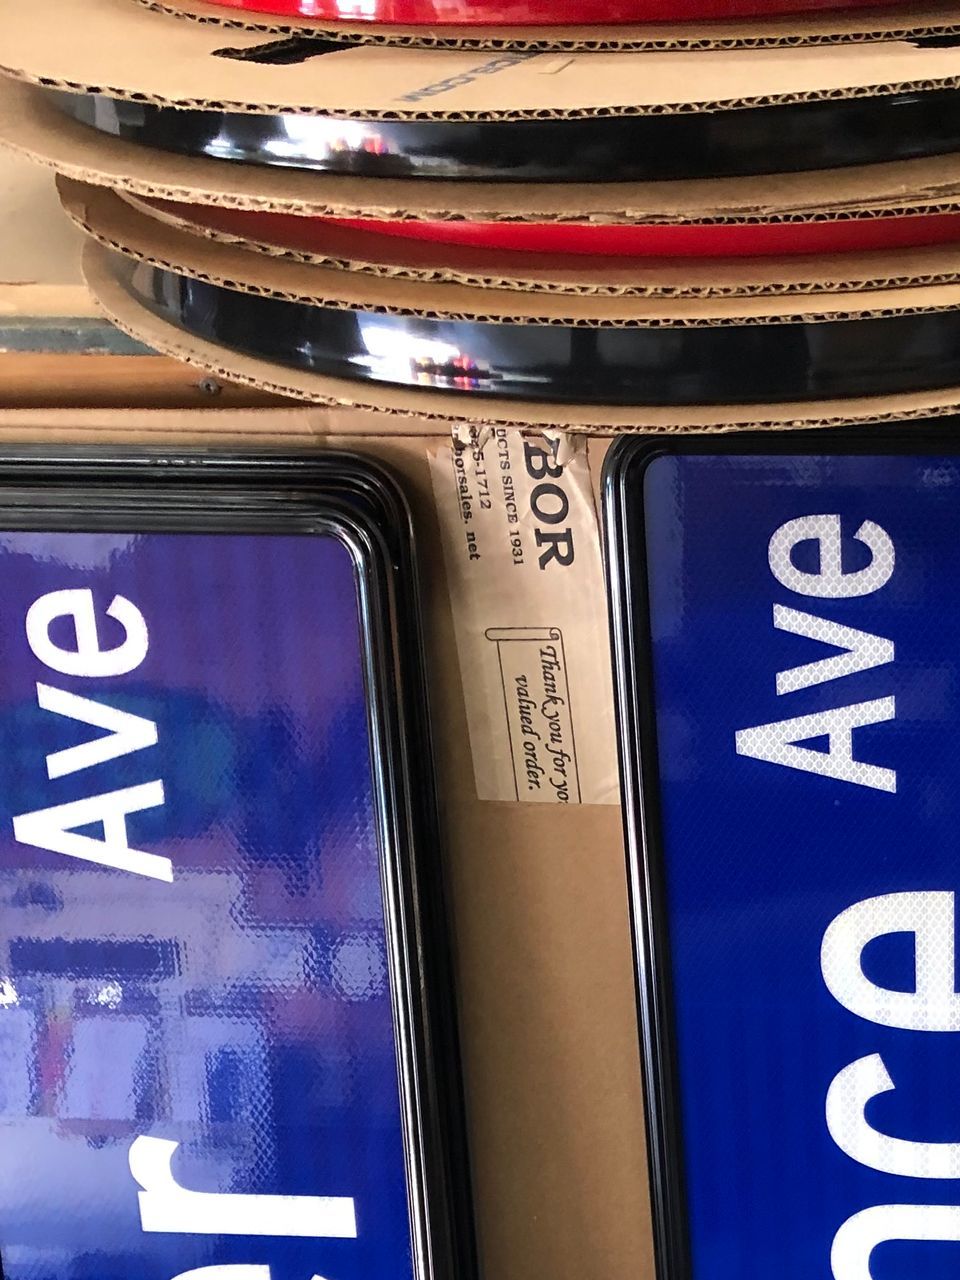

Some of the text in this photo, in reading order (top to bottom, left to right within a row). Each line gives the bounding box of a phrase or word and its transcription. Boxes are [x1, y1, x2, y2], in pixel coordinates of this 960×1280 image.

[496, 428, 524, 566] UCTS SINCE 1931
[523, 441, 575, 570] BOR
[539, 645, 571, 804] Thank you for yo
[735, 514, 897, 793] Ave
[12, 588, 175, 884] Ave
[515, 674, 545, 791] valued order.
